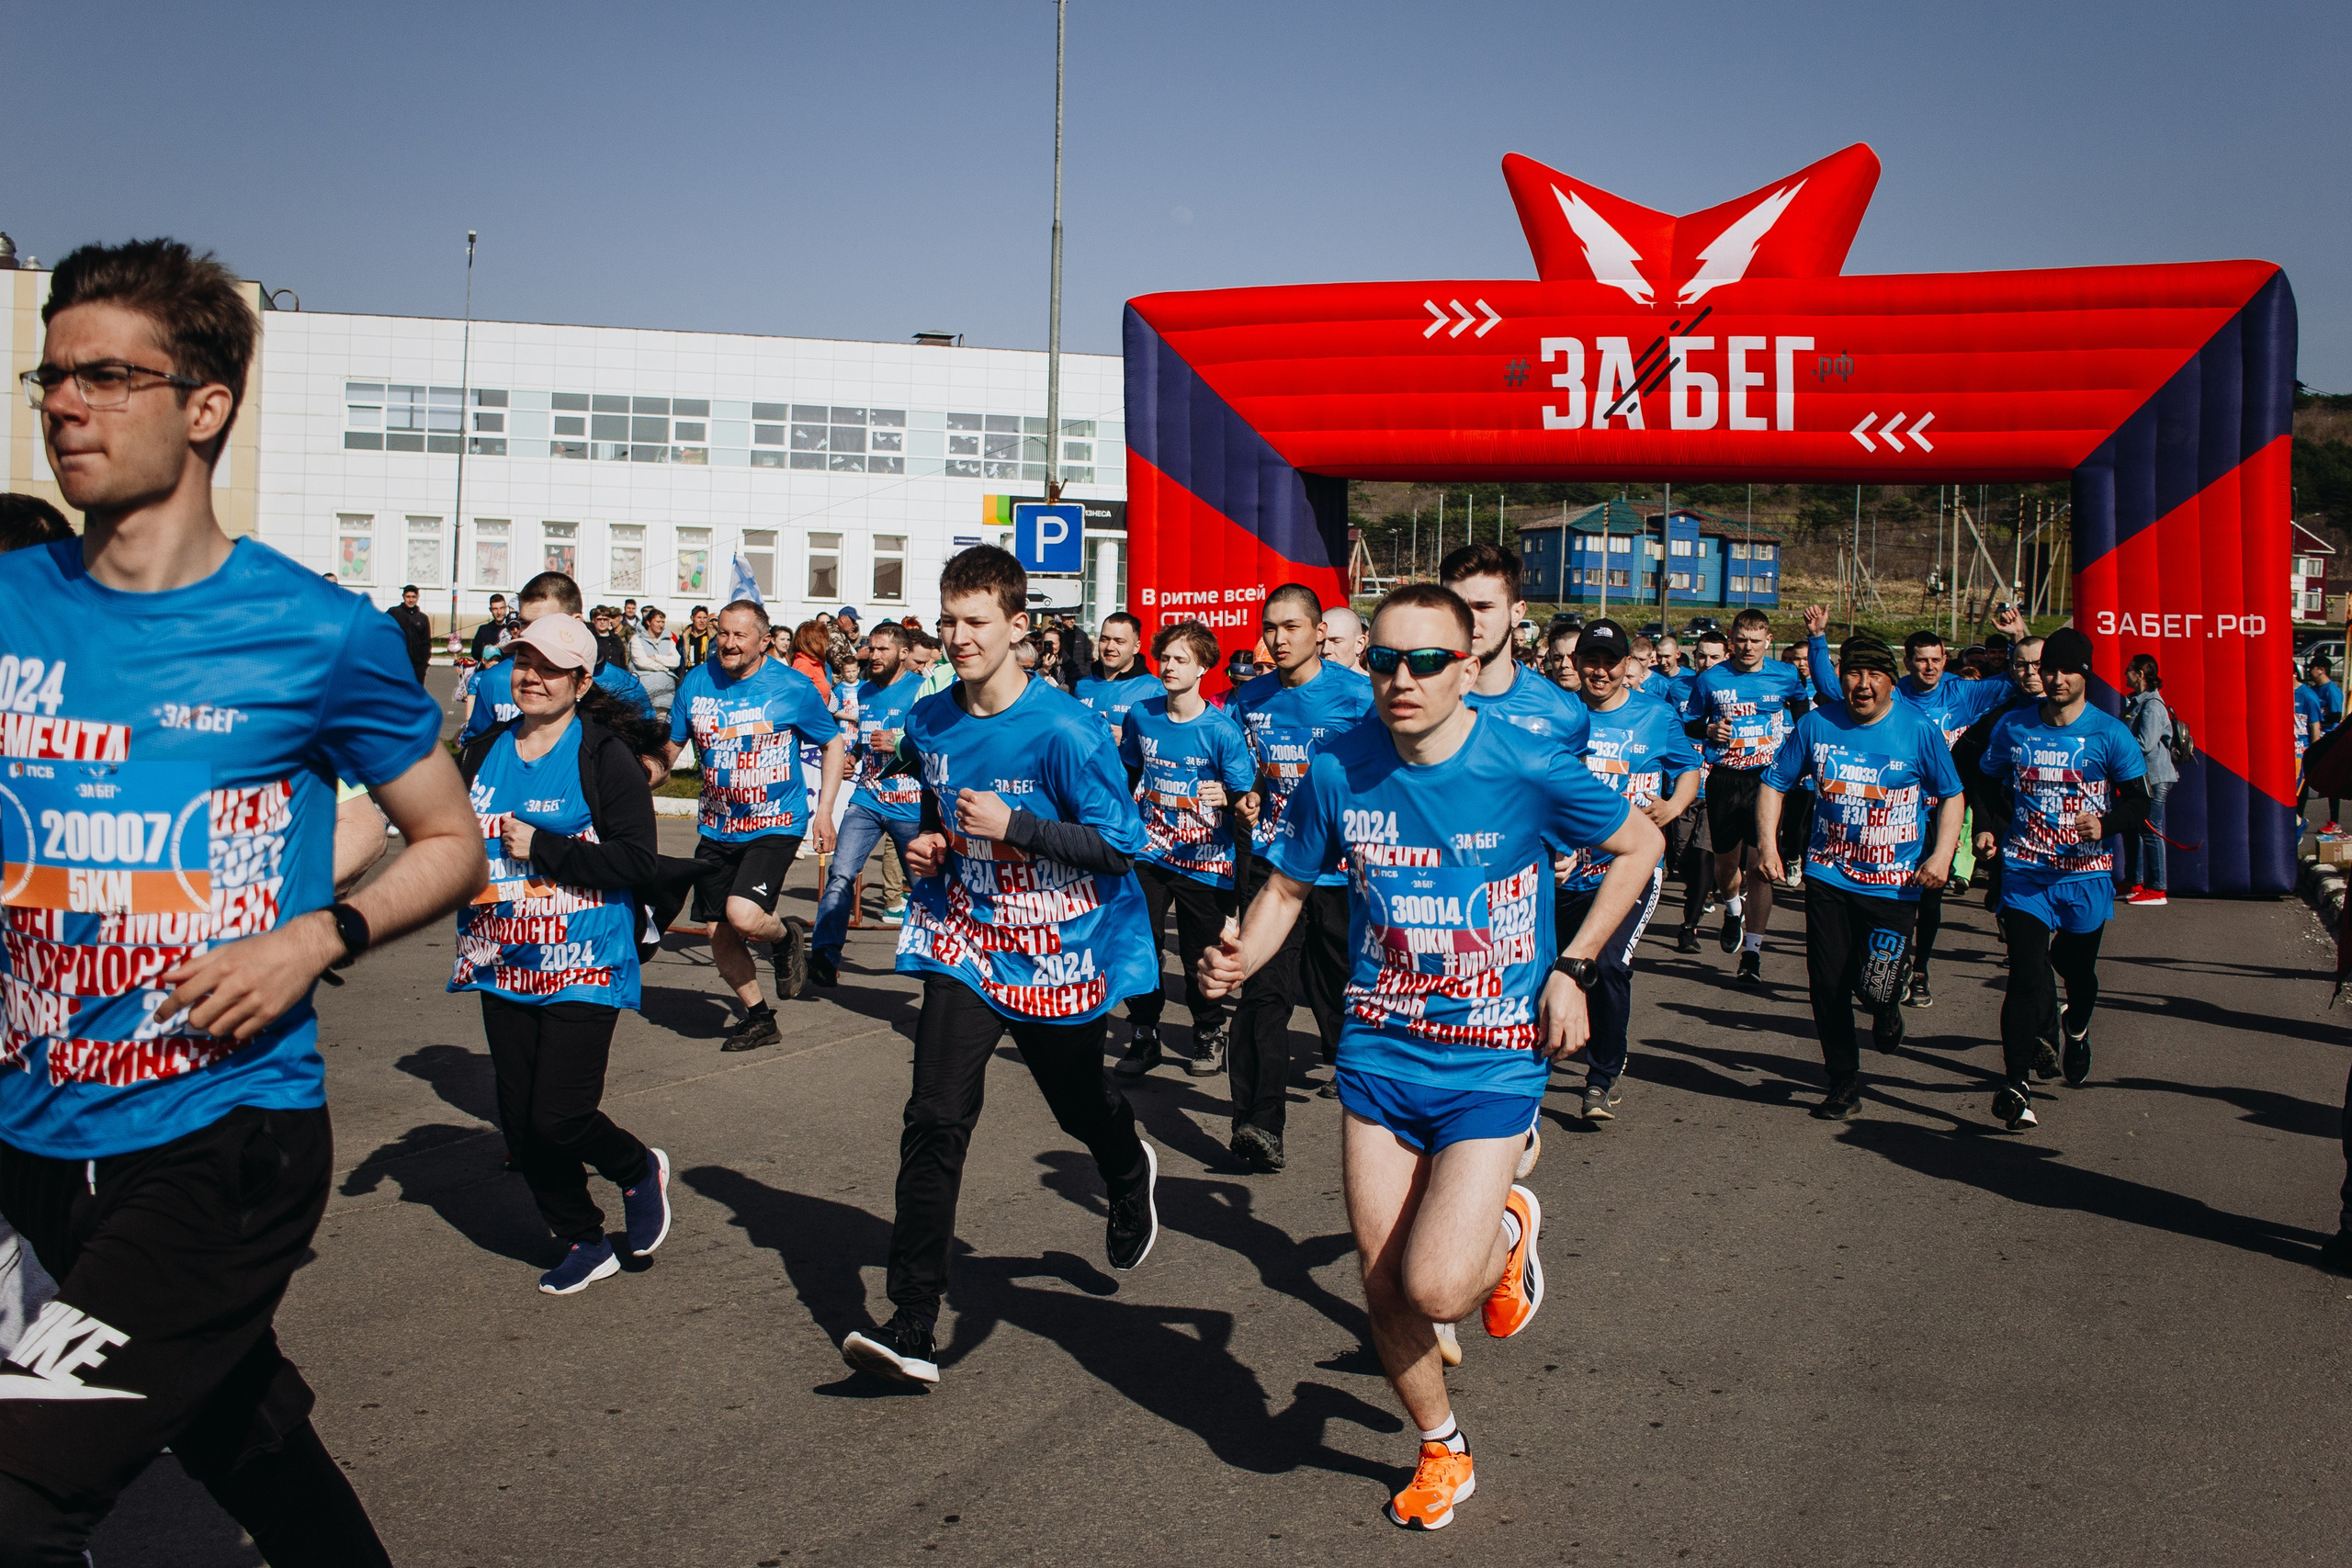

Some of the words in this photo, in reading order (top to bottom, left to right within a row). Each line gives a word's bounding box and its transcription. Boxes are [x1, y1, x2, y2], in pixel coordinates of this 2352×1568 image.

[1035, 516, 1069, 562] P
[1142, 589, 1156, 605] В
[1160, 591, 1219, 607] ритме
[1224, 584, 1266, 603] всей
[2097, 611, 2267, 638] ЗАБЕГ.РФ
[729, 707, 762, 725] 20008
[1738, 726, 1764, 738] 20015
[714, 747, 790, 770] #ЗАБЕГ2024
[1270, 745, 1306, 761] 20064
[2034, 750, 2068, 766] 30012
[26, 765, 55, 779] ПСБ
[729, 765, 791, 788] #МОМЕНТ
[1839, 764, 1877, 783] 20033
[1154, 777, 1188, 795] 20002
[1343, 809, 1399, 844] 2024
[1842, 804, 1917, 827] #ЗАБЕГ2024
[41, 809, 172, 863] 20007
[1860, 823, 1918, 846] #МОМЕНТ
[1195, 843, 1226, 862] 2024
[1381, 870, 1398, 878] ПСБ
[989, 875, 1101, 924] #МОМЕНТ
[1391, 895, 1464, 925] 30014
[539, 941, 595, 972] 2024
[1033, 948, 1096, 987] 2024
[495, 965, 613, 995] #ЕДИНСТВО
[1467, 996, 1530, 1026] 2024
